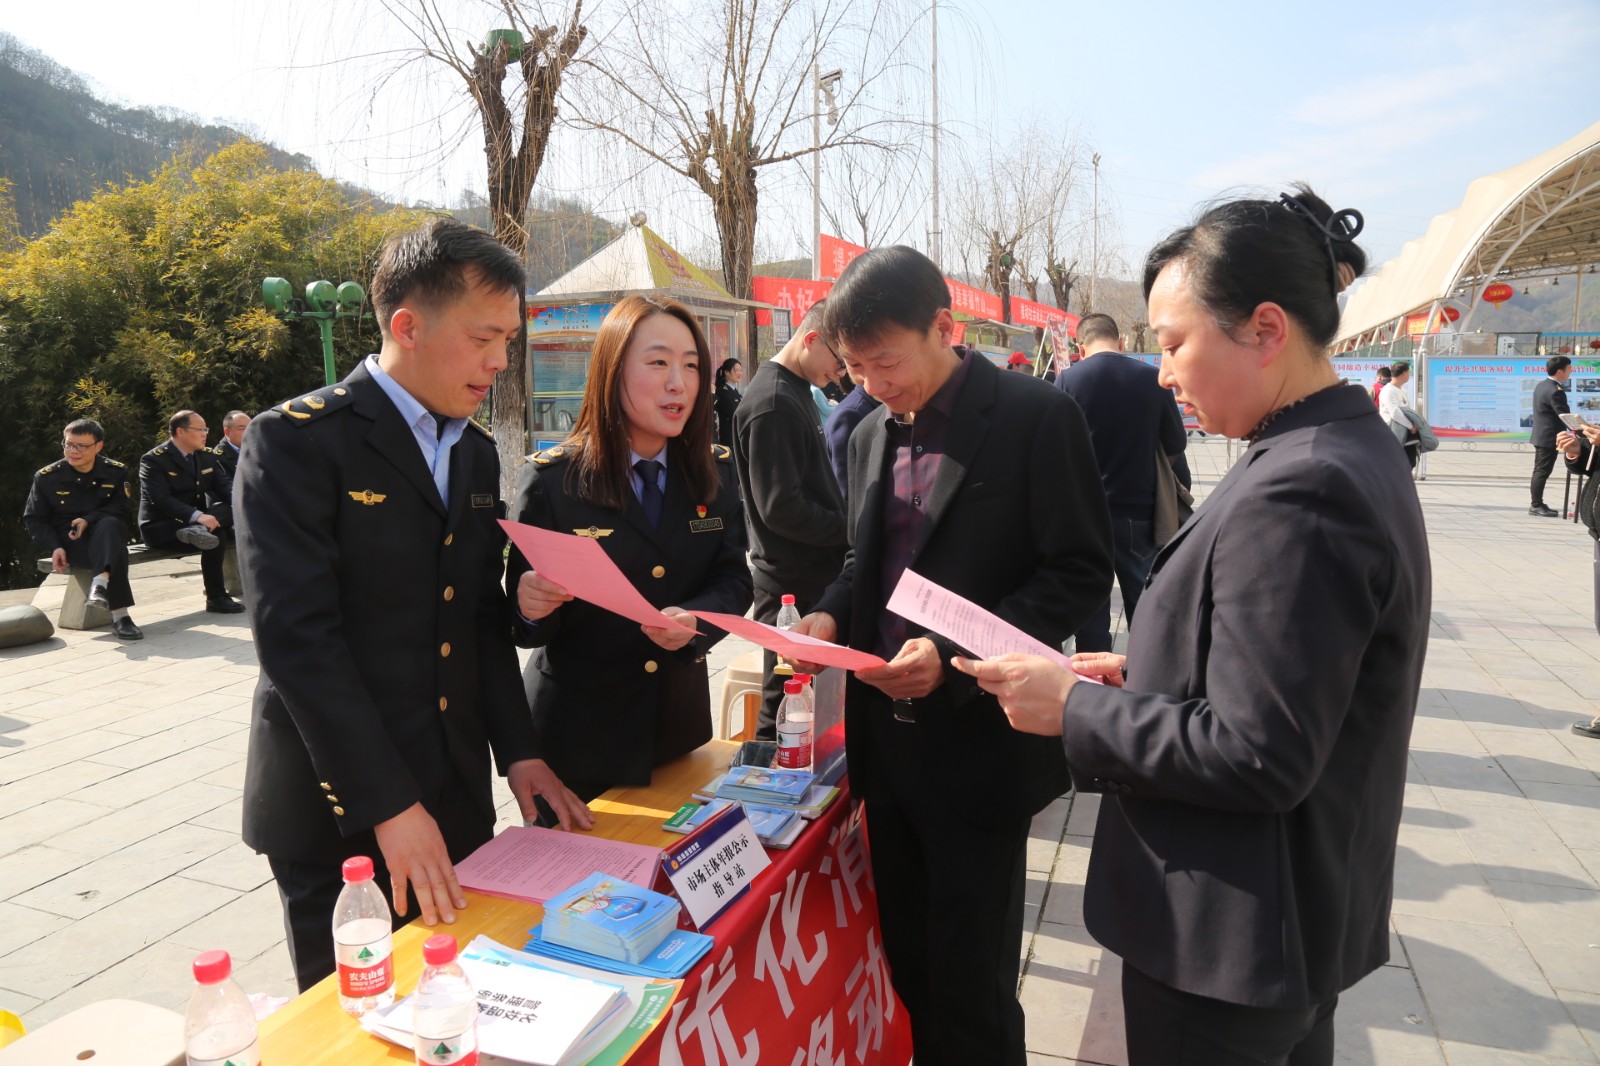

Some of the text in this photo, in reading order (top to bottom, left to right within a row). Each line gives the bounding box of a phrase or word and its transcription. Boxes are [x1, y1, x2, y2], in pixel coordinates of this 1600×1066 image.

[777, 286, 828, 318] 办好
[1444, 365, 1514, 373] 提升公共服务质量
[686, 834, 749, 891] 市场主体年报公示
[712, 863, 746, 898] 指导站
[349, 967, 385, 981] 农夫山泉
